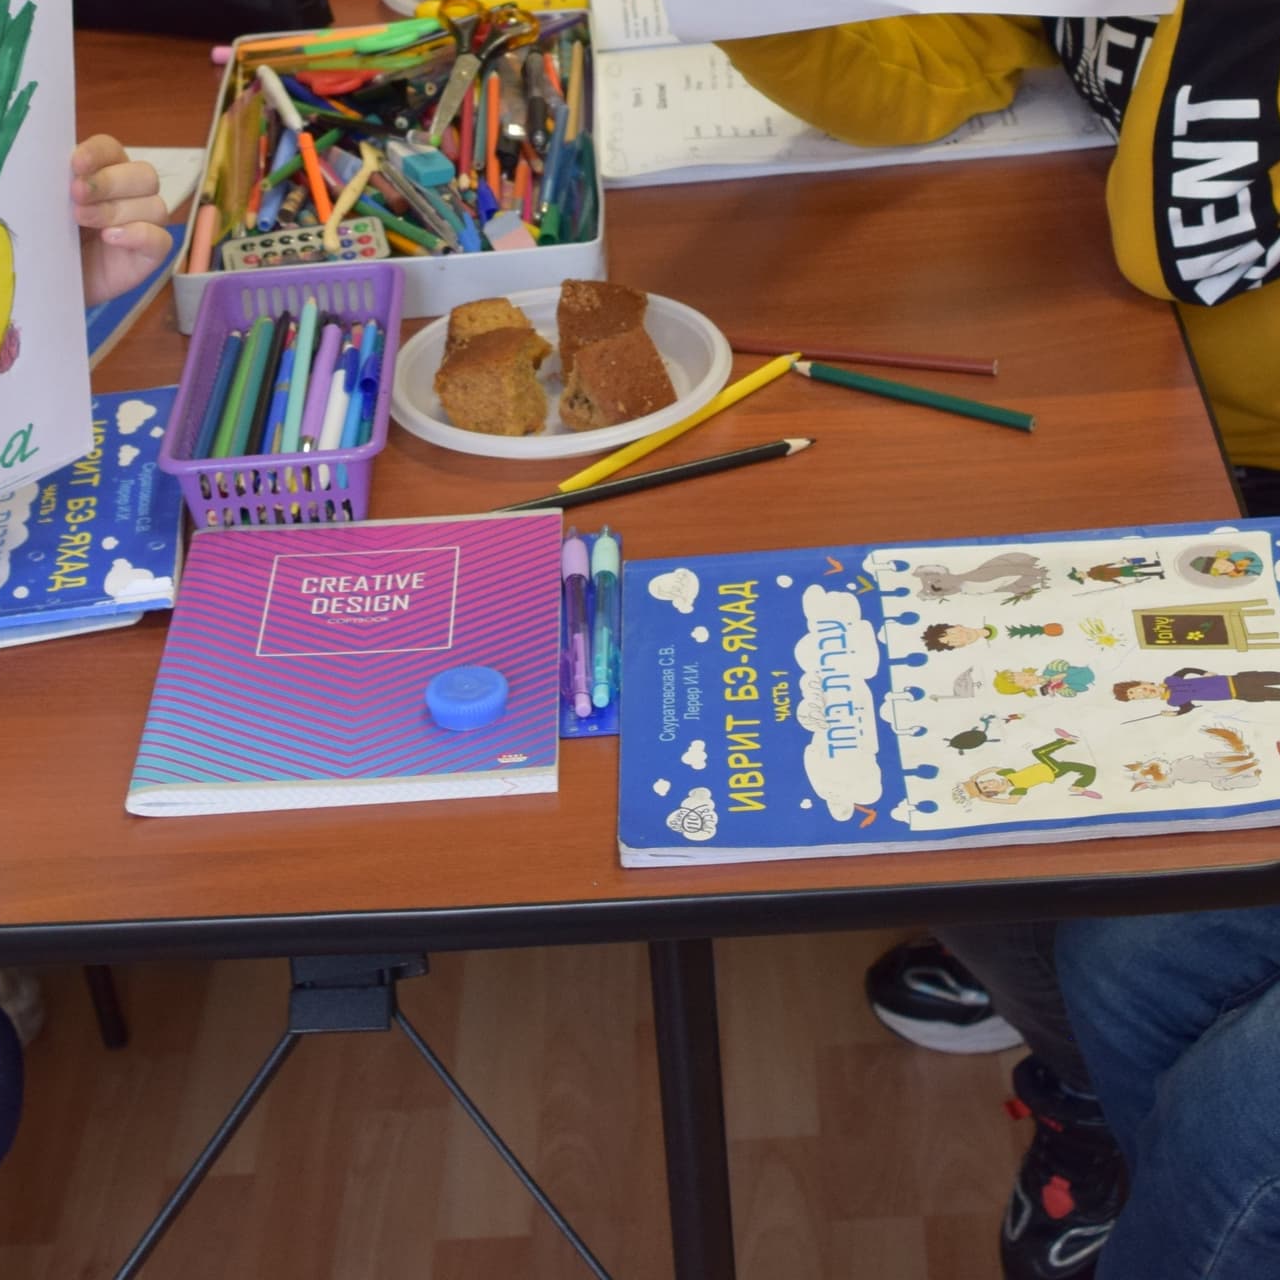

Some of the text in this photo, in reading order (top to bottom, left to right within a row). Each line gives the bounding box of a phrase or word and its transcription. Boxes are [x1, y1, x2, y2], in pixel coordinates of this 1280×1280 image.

[39, 484, 57, 515] ЧАСТЬ
[47, 496, 98, 593] БЭ-ЯХАД
[301, 572, 427, 596] CREATIVE
[310, 594, 410, 616] DESIGN
[658, 644, 680, 742] Скуратовская С.В.
[682, 662, 704, 720] Лерер И.И.
[718, 580, 767, 812] ИВРИТ БЭ-ЯХАД
[770, 669, 792, 722] ЧАСТЬ 1
